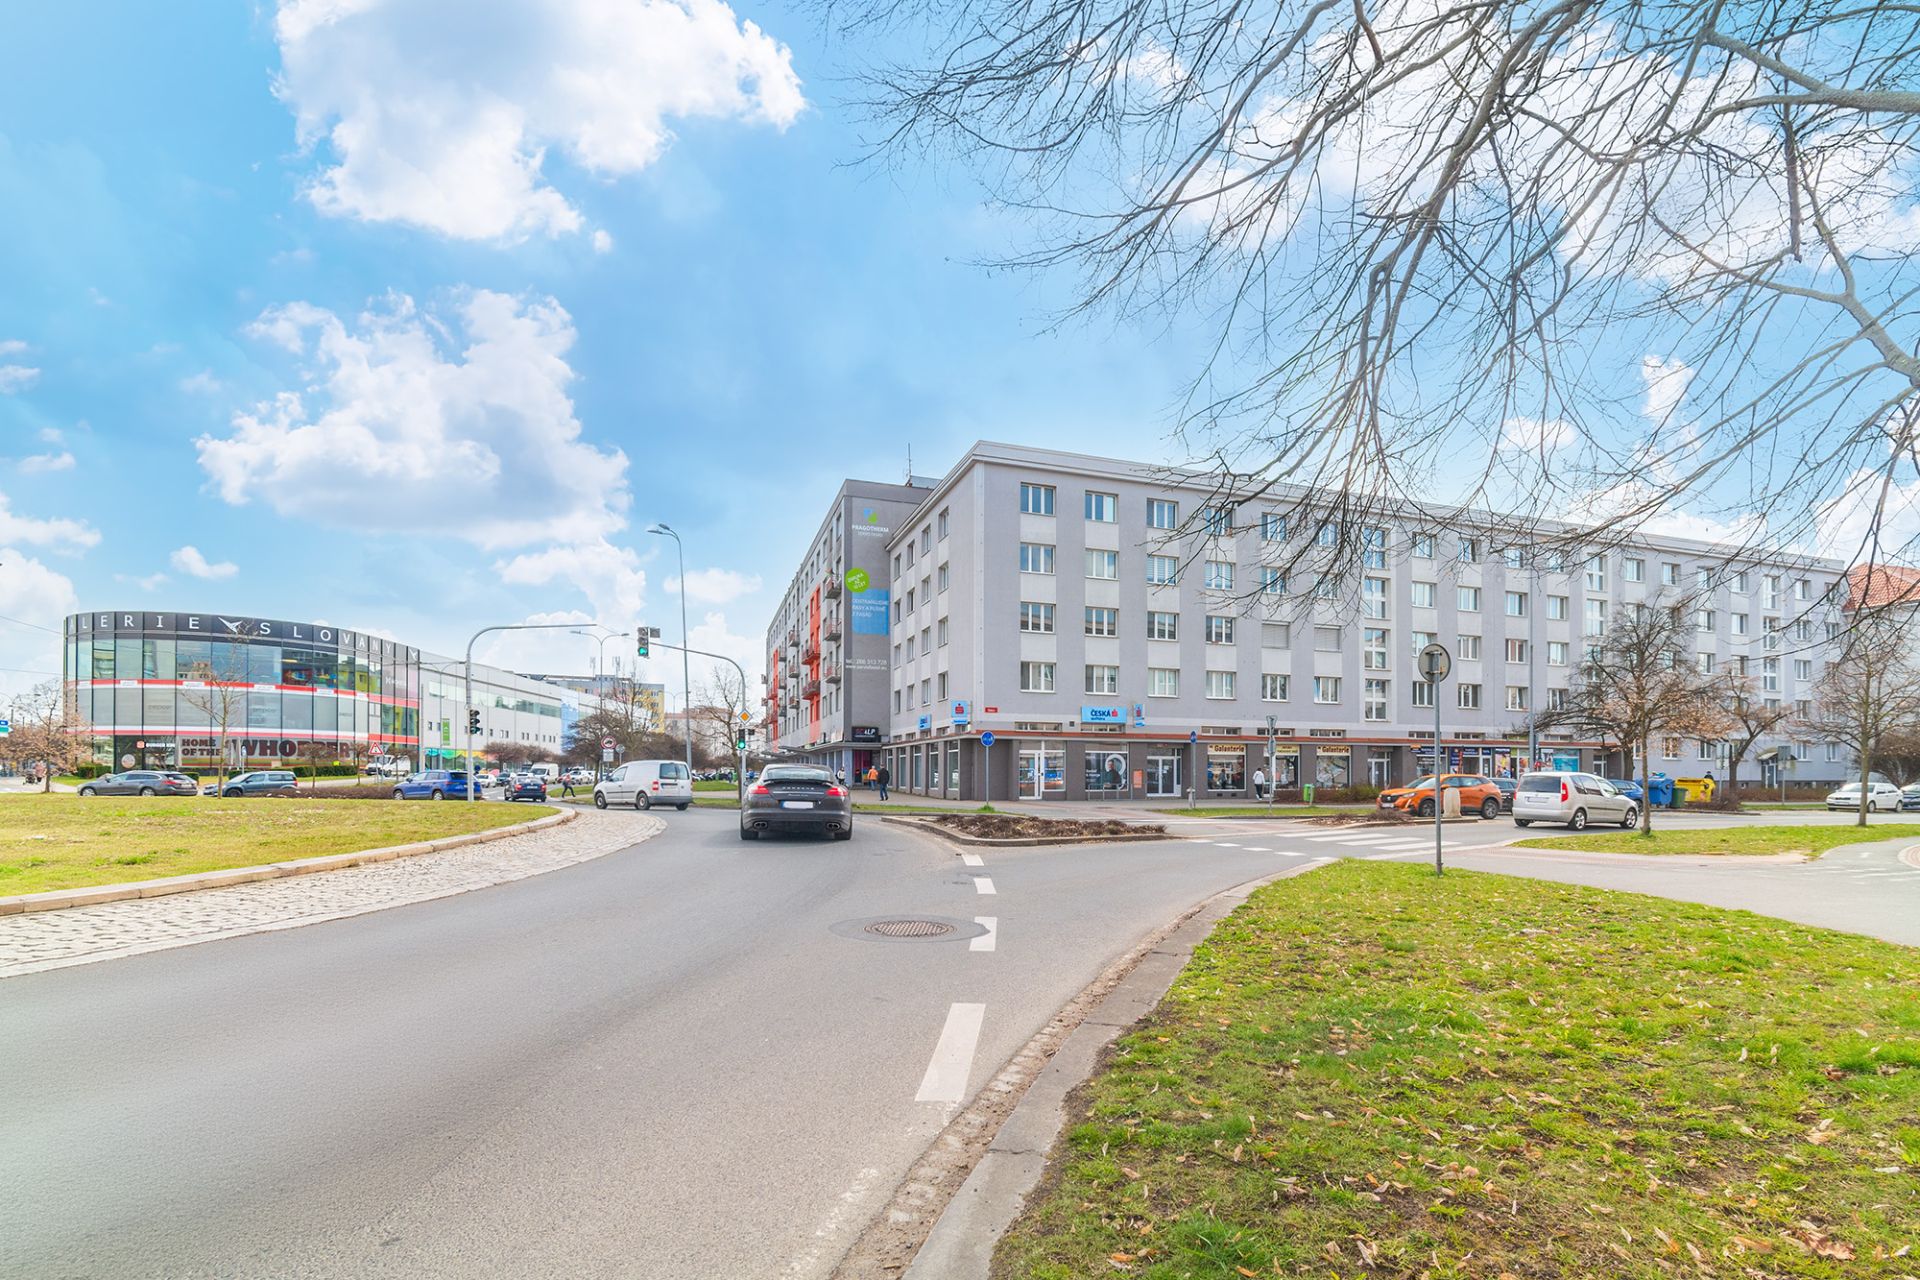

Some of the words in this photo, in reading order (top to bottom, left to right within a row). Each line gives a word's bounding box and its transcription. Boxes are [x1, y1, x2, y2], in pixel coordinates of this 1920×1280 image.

[260, 622, 392, 653] SLOVANY
[1090, 709, 1111, 717] ČESKÁ
[182, 748, 197, 756] OF
